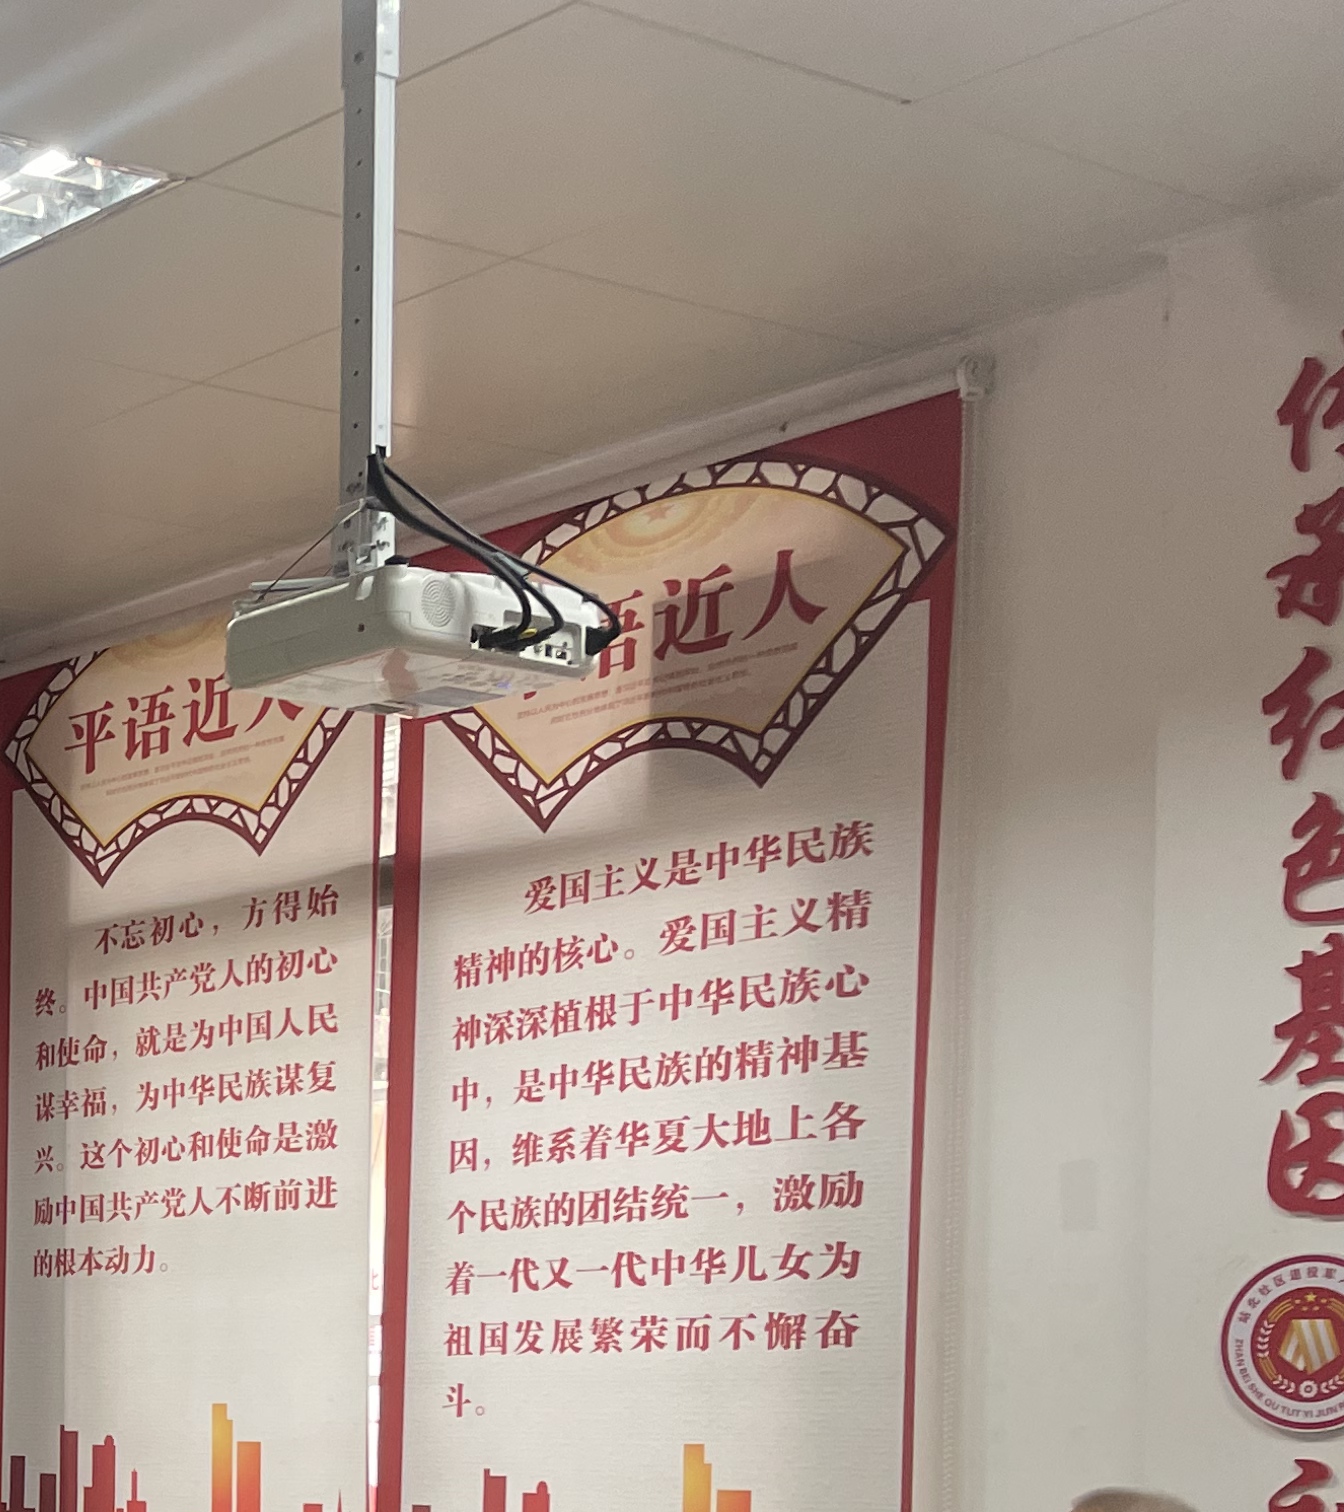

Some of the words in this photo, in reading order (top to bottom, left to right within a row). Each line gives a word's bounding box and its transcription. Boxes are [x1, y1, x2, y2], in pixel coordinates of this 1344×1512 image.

[523, 819, 874, 915] 爱国主义是中华民族
[94, 884, 340, 955] 不忘初心，方得始
[453, 889, 872, 989] 精神的核心。爱国主义精
[34, 945, 339, 1018] 终。中国共产党人的初心
[452, 963, 870, 1051] 神深深植根于中华民族心
[34, 1002, 339, 1071] 和使命，就是为中国人民
[34, 1060, 338, 1123] 谋幸福，为中华民族谋复
[451, 1030, 868, 1113] 中，是中华民族的精神基
[34, 1118, 339, 1175] 兴。这个初心和使命是激
[449, 1100, 866, 1175] 因，维系着华夏大地上各
[33, 1175, 339, 1228] 励中国共产党人不断前进
[446, 1170, 864, 1235] 个民族的团结统一，激励
[33, 1244, 170, 1279] 的根本动力。
[445, 1241, 862, 1297] 着一代又一代中华儿女为
[444, 1309, 860, 1357] 祖国发展繁荣而不懈奋
[441, 1382, 486, 1419] 斗。
